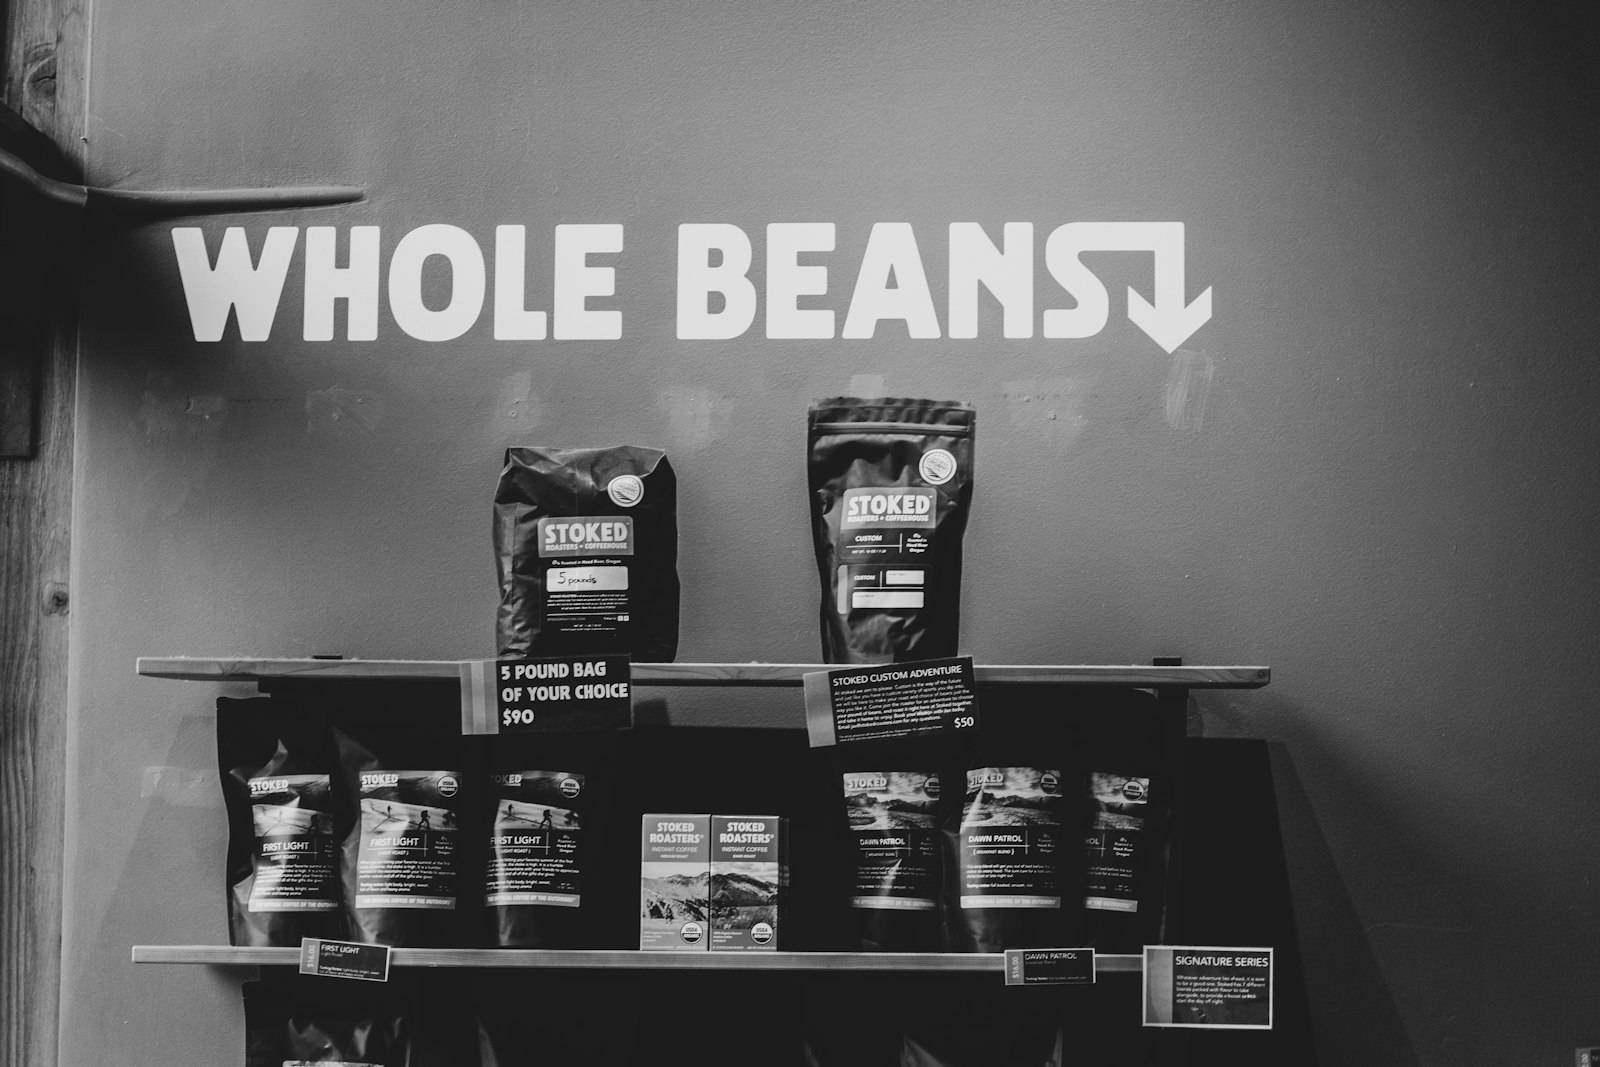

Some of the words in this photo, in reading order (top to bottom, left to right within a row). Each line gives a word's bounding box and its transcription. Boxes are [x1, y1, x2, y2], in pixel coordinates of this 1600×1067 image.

[171, 224, 624, 342] WHOLE
[676, 221, 1112, 340] BEANS
[848, 494, 930, 516] STOKED
[545, 522, 628, 544] STOKED
[557, 571, 566, 584] 5
[568, 574, 597, 586] pounds
[501, 665, 510, 680] 5
[514, 663, 569, 680] POUND
[573, 661, 606, 678] BAG
[833, 675, 868, 686] STOKED
[870, 671, 908, 682] CUSTOM
[910, 666, 962, 678] ADVENTURE
[502, 687, 522, 702] OF
[527, 685, 571, 701] YOUR
[575, 683, 629, 700] CHOICE
[502, 708, 535, 726] $90
[954, 716, 974, 728] $50
[362, 774, 398, 784] STOKED
[848, 777, 887, 788] STOKED
[970, 773, 1004, 785] STOKED
[250, 780, 288, 792] STOKED
[657, 822, 695, 832] STOKED
[727, 822, 765, 832] STOKED
[370, 838, 390, 846] FIRST
[393, 837, 419, 846] LIGHT
[490, 836, 513, 845] FIRST
[514, 836, 541, 844] LIGHT
[649, 833, 700, 843] ROASTERS
[720, 833, 770, 843] ROASTERS
[263, 842, 282, 852] FIRST
[283, 841, 309, 850] LIGHT
[307, 945, 316, 968] $16.00
[1175, 956, 1232, 966] SIGNATURE
[1234, 957, 1268, 967] SERIES
[1012, 956, 1020, 979] $16.00
